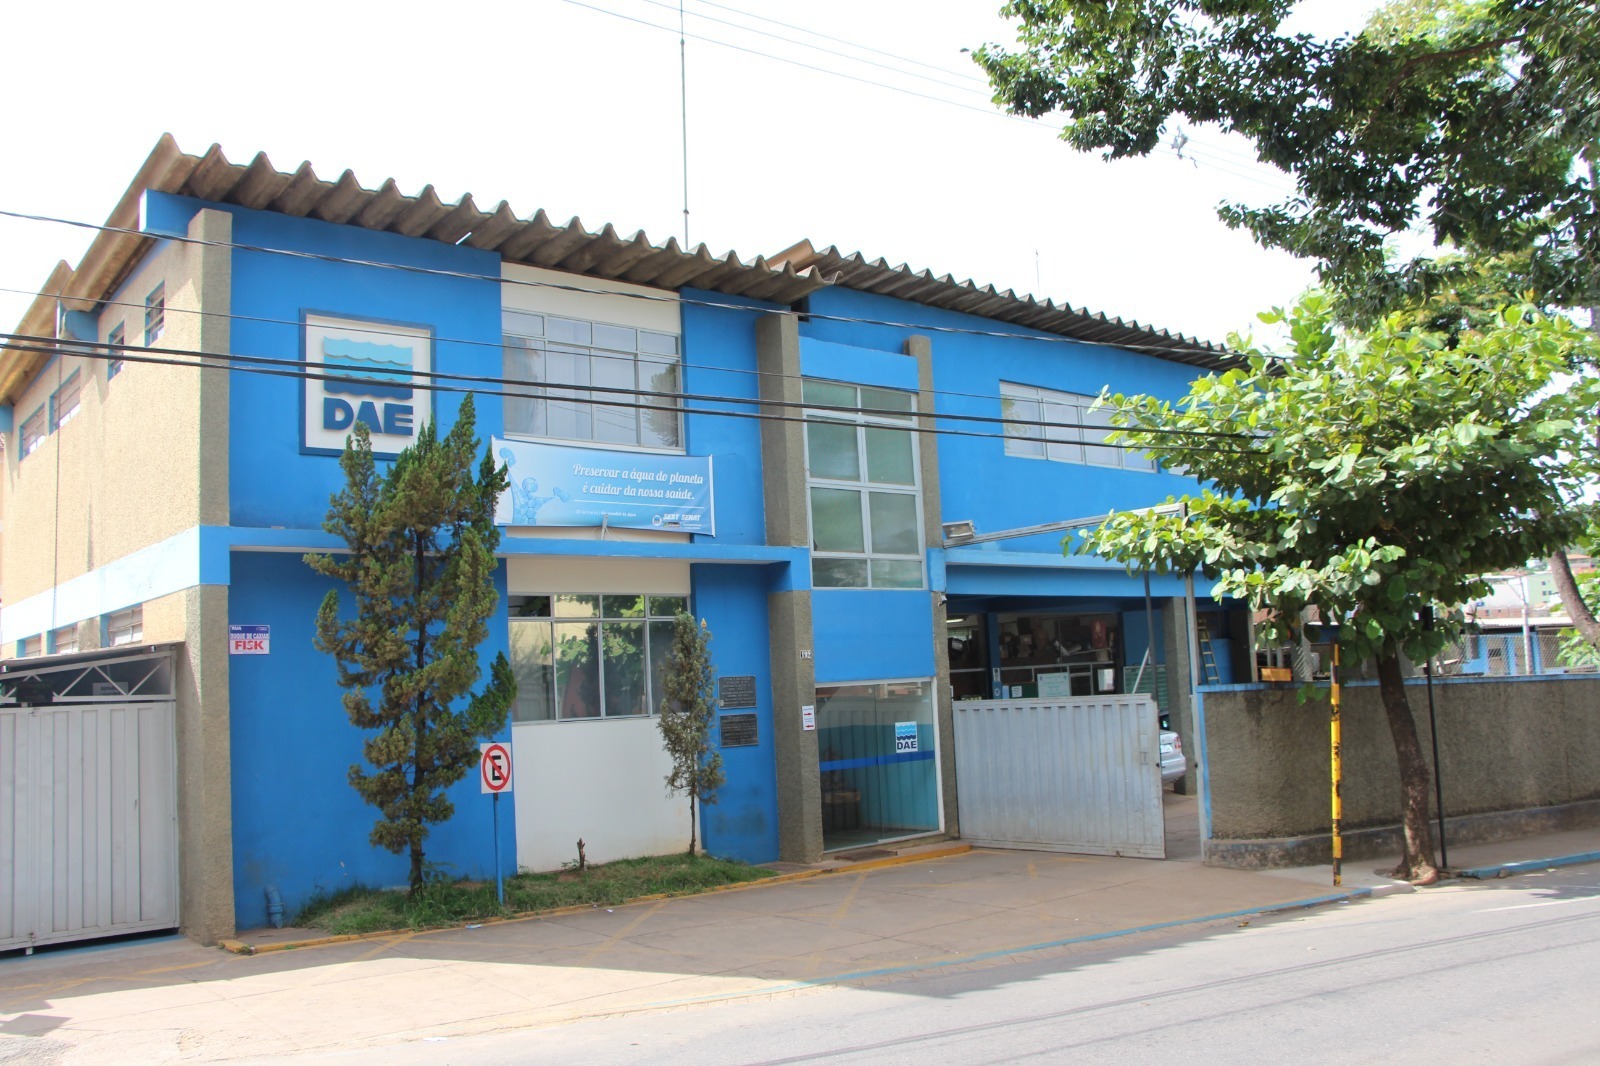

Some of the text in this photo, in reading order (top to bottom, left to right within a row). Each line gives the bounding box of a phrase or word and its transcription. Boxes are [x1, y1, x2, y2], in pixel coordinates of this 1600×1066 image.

[323, 397, 413, 436] DAE
[574, 464, 703, 485] Preservar a água do planeta
[583, 482, 695, 500] é cuidar da nossa saúde.
[235, 640, 264, 650] FISK
[897, 740, 917, 751] DAE
[492, 755, 501, 780] E
